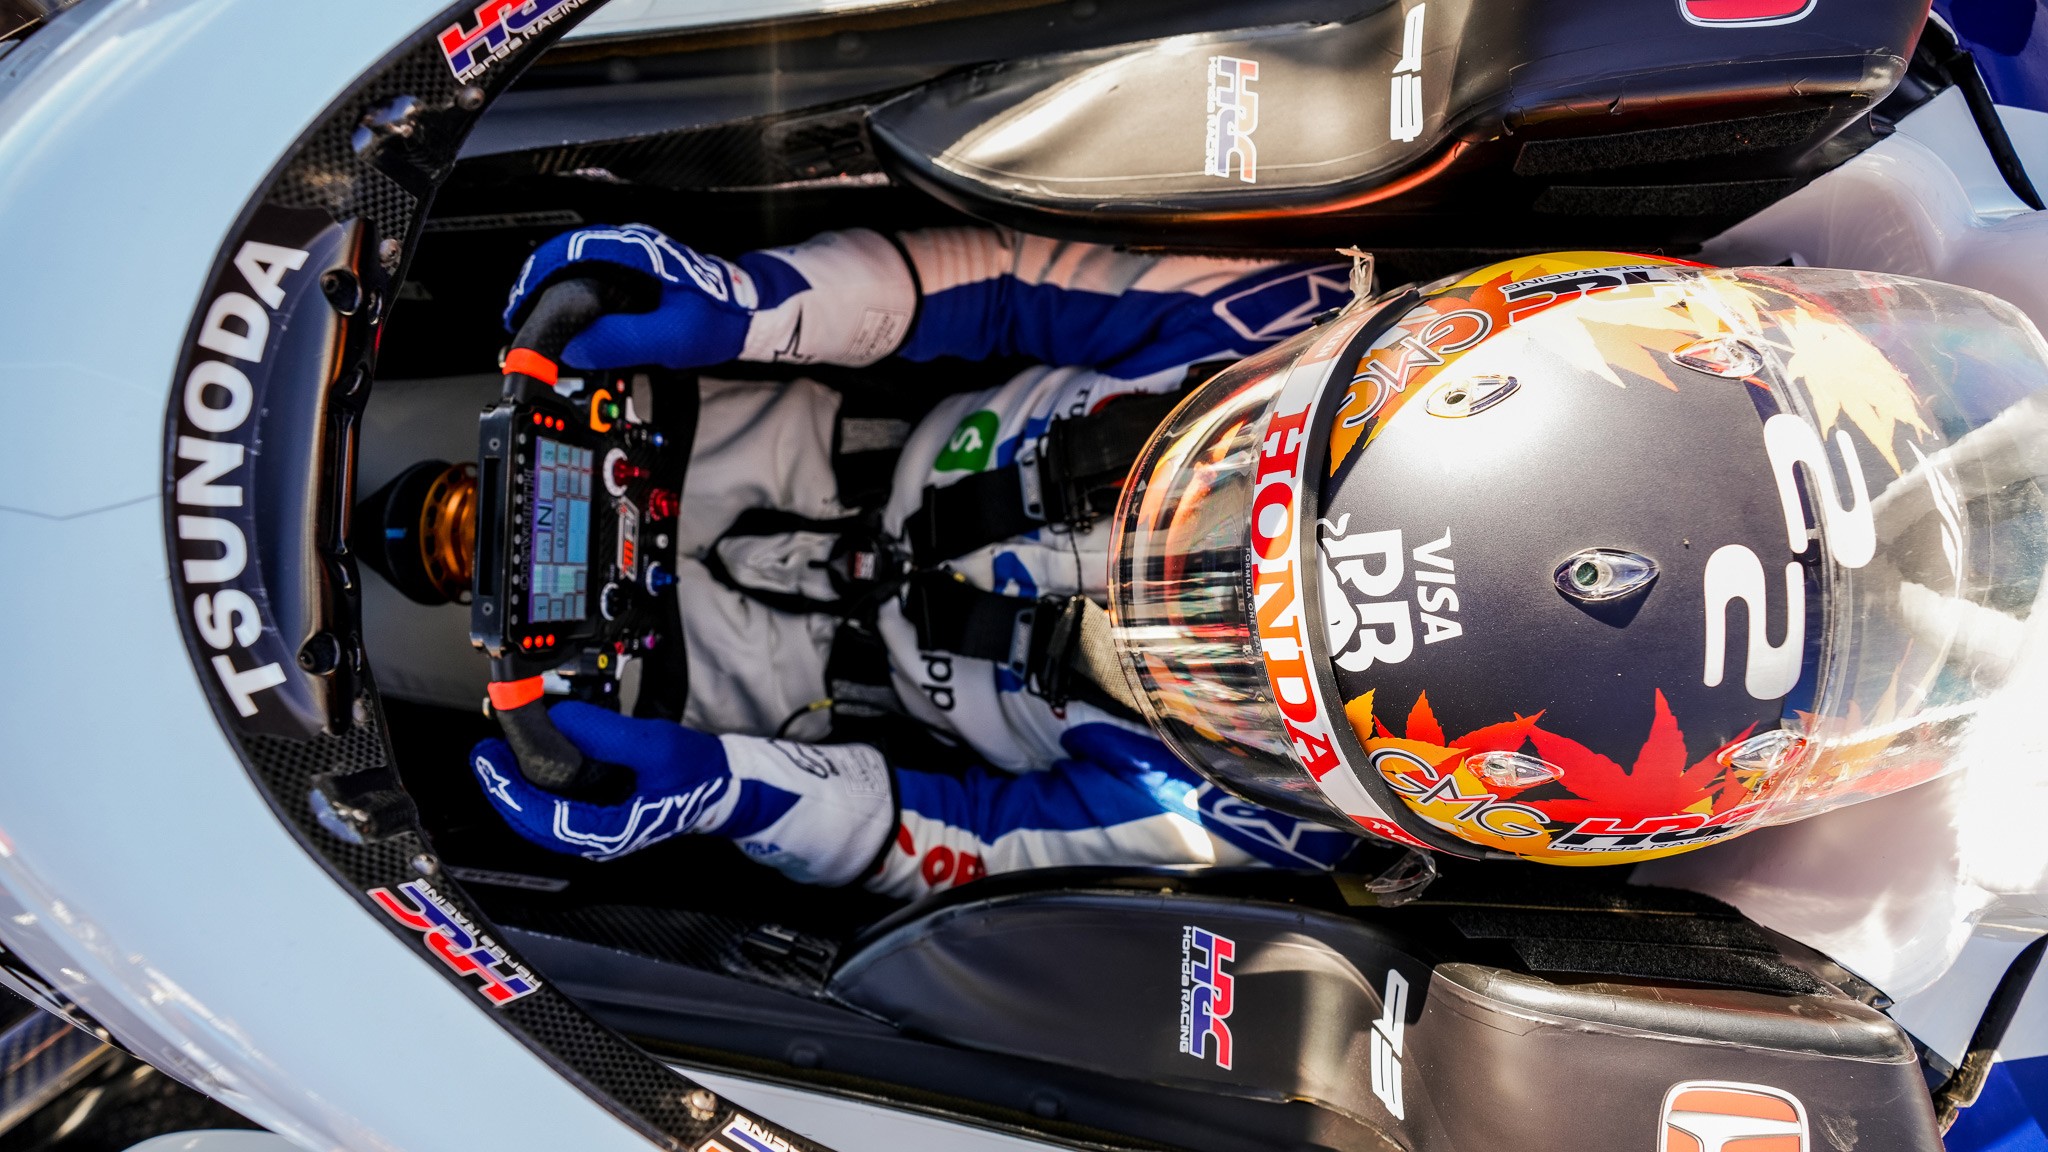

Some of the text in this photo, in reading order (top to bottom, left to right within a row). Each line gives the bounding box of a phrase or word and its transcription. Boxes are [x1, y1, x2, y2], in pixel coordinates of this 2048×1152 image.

[458, 37, 523, 85] Honda
[1205, 55, 1217, 176] Honda RACING
[1217, 55, 1260, 184] HRC
[1502, 269, 1601, 292] RACING
[176, 239, 310, 718] TSUNODA
[1244, 547, 1253, 599] FORMULA
[1247, 602, 1256, 625] ONE
[1251, 402, 1341, 784] HONDA
[1325, 528, 1414, 673] RB
[1412, 525, 1464, 645] VISA
[920, 654, 957, 711] pp
[1369, 747, 1551, 839] GMG
[366, 881, 541, 1008] HRC
[415, 877, 481, 937] RACING
[480, 934, 543, 991] Honda
[1180, 925, 1192, 1054] Honda RACING
[1190, 926, 1236, 1071] HRC
